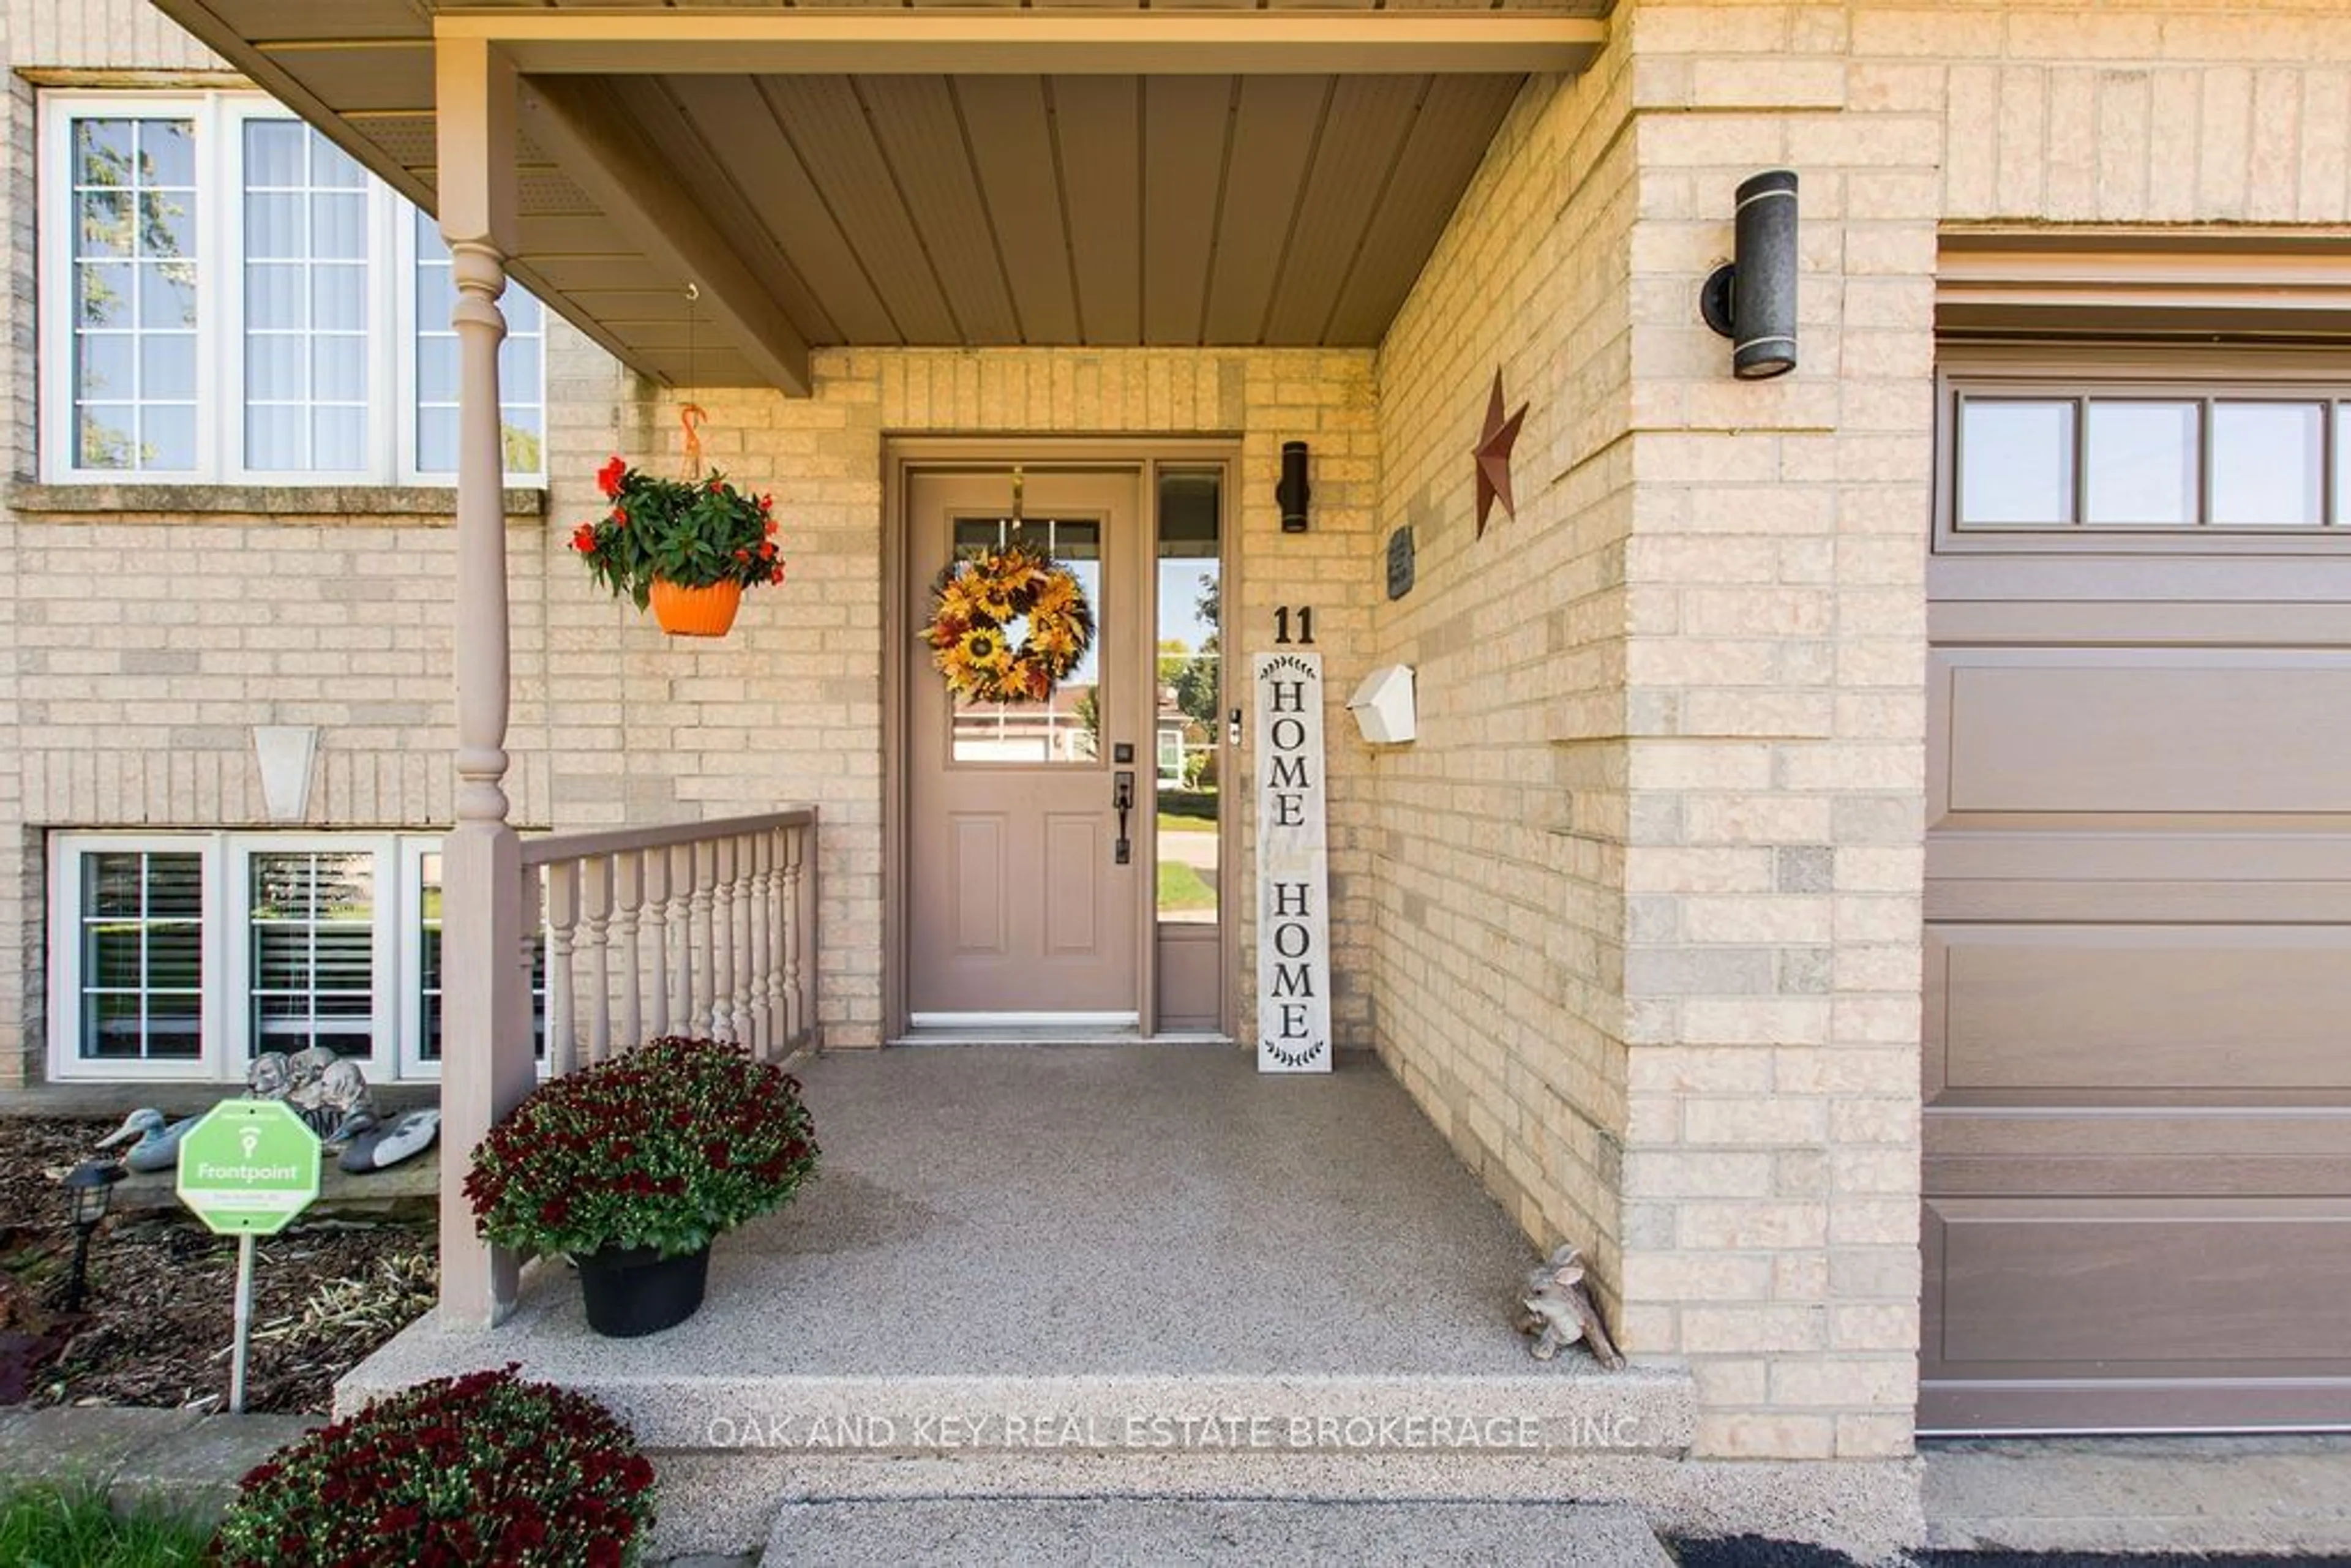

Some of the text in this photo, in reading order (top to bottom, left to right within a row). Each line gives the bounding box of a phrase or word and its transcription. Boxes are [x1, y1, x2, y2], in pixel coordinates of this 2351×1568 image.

[1274, 606, 1314, 644] 11
[1267, 680, 1314, 1039] HOME HOME
[197, 1163, 298, 1184] Frontpoint
